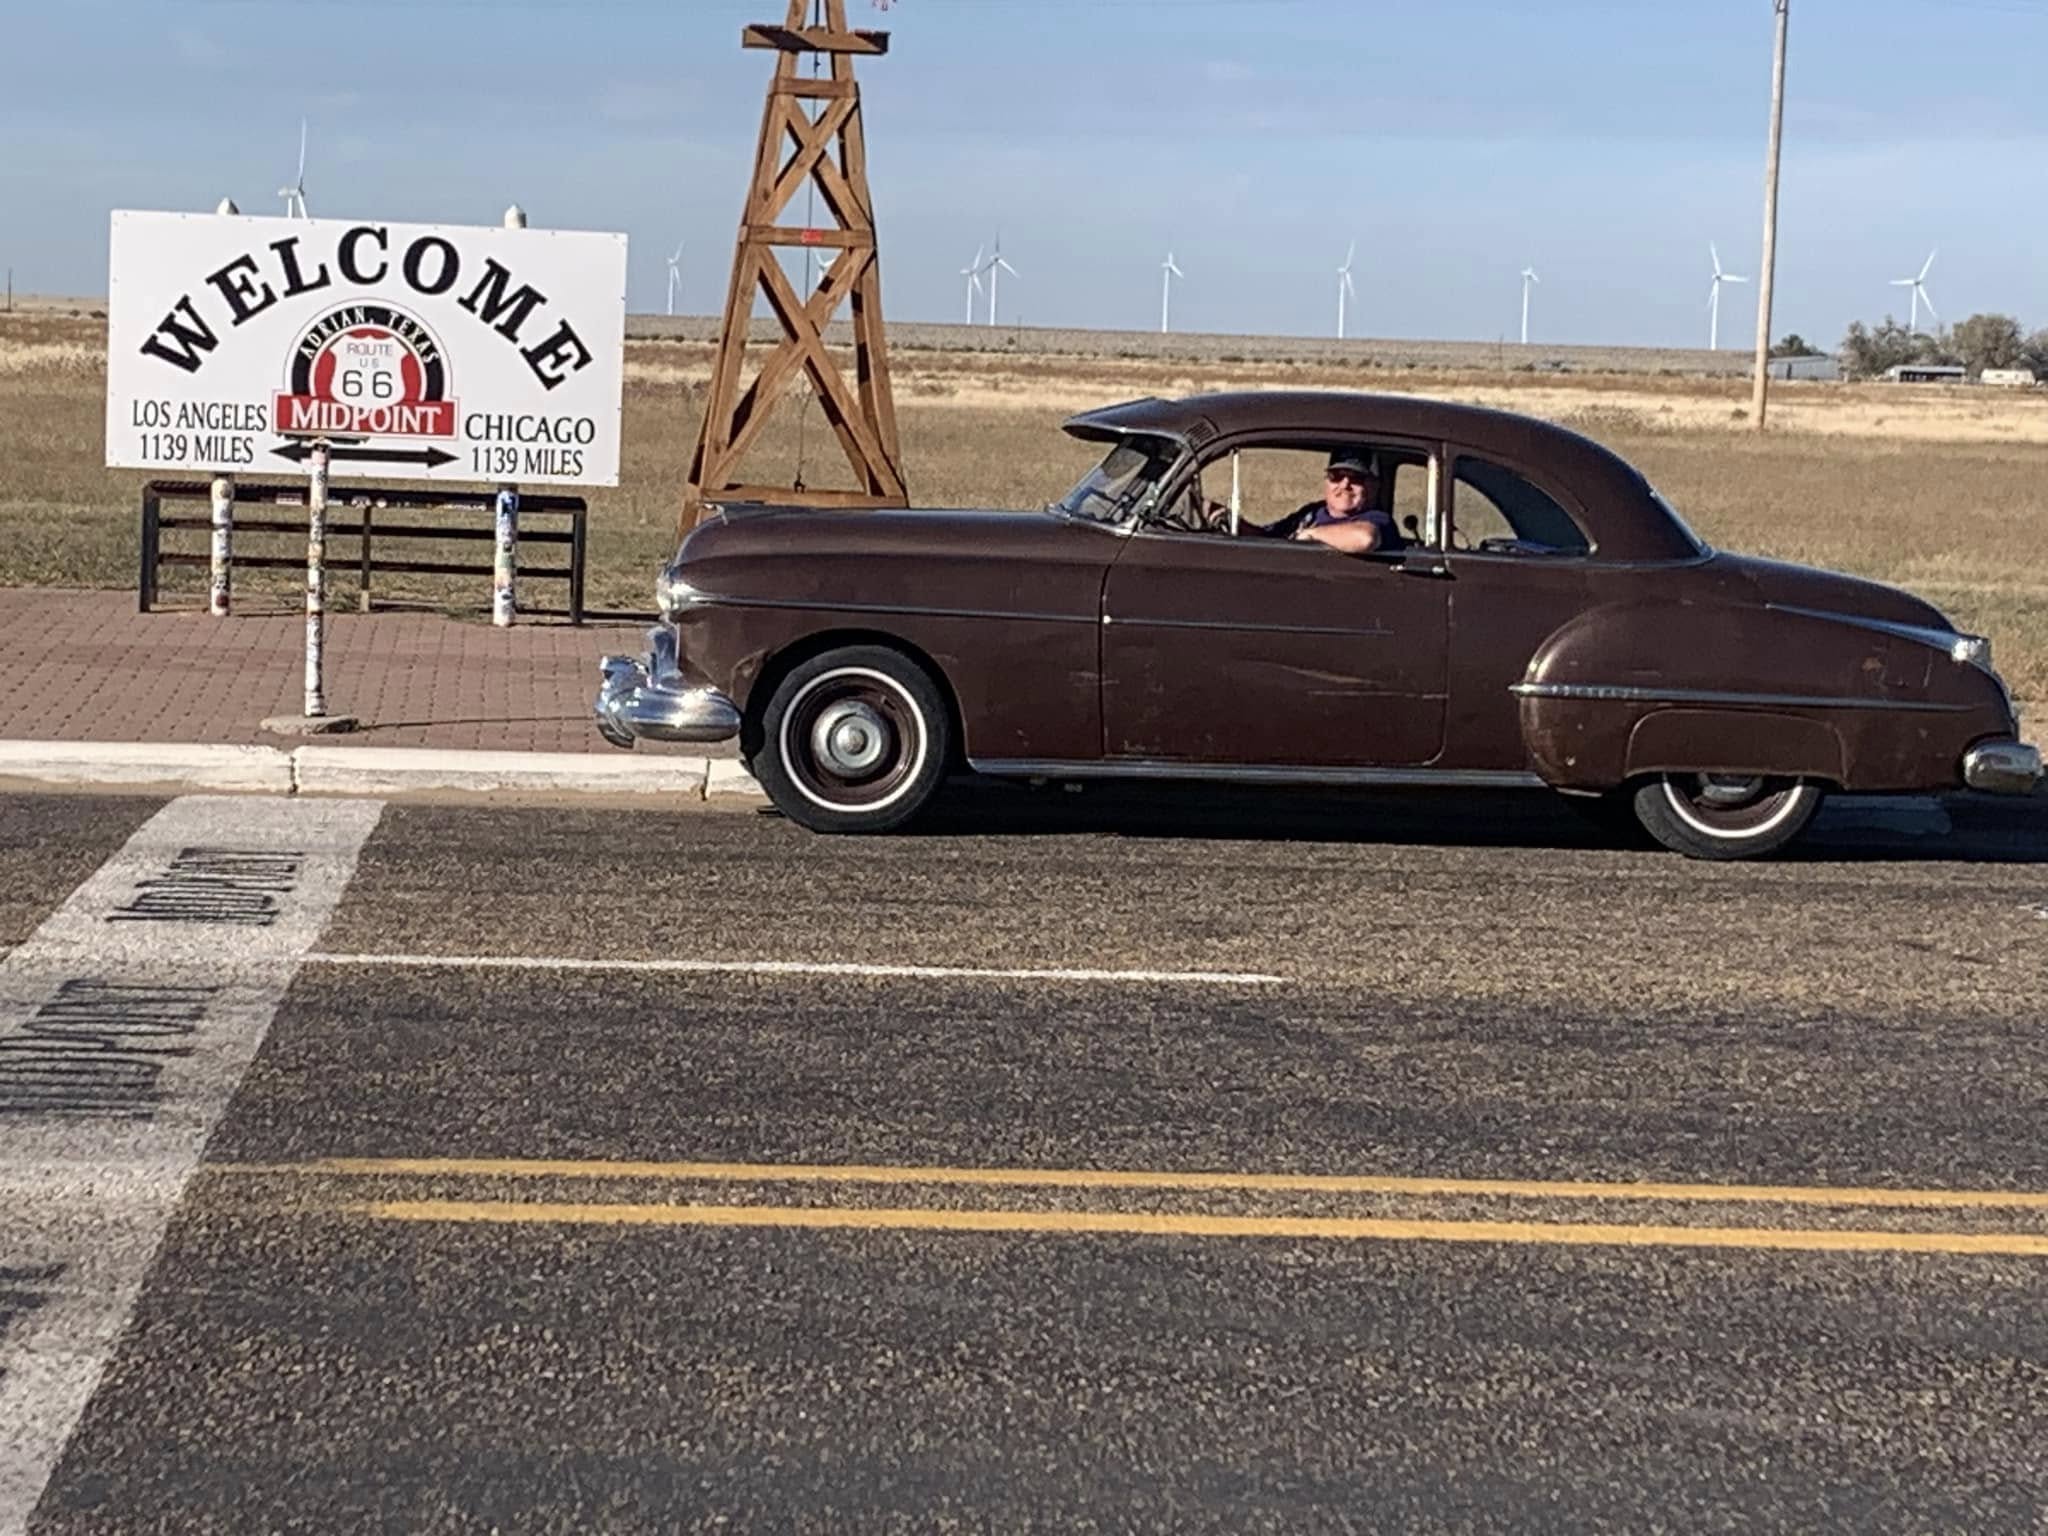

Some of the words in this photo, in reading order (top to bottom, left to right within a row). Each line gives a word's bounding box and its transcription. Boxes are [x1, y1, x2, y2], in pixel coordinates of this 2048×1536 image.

[140, 226, 593, 391] WELCOME
[346, 343, 394, 357] ROUTE
[388, 311, 440, 364] TEXAS
[341, 369, 393, 399] 66
[133, 399, 172, 428] LOS
[175, 402, 267, 432] ANGELES
[290, 399, 442, 434] MIDPOINT
[465, 413, 596, 444] CHICAGO
[140, 433, 188, 461] 1139
[194, 434, 254, 464] MILES
[472, 446, 519, 475] 1139
[523, 448, 584, 477] MILES
